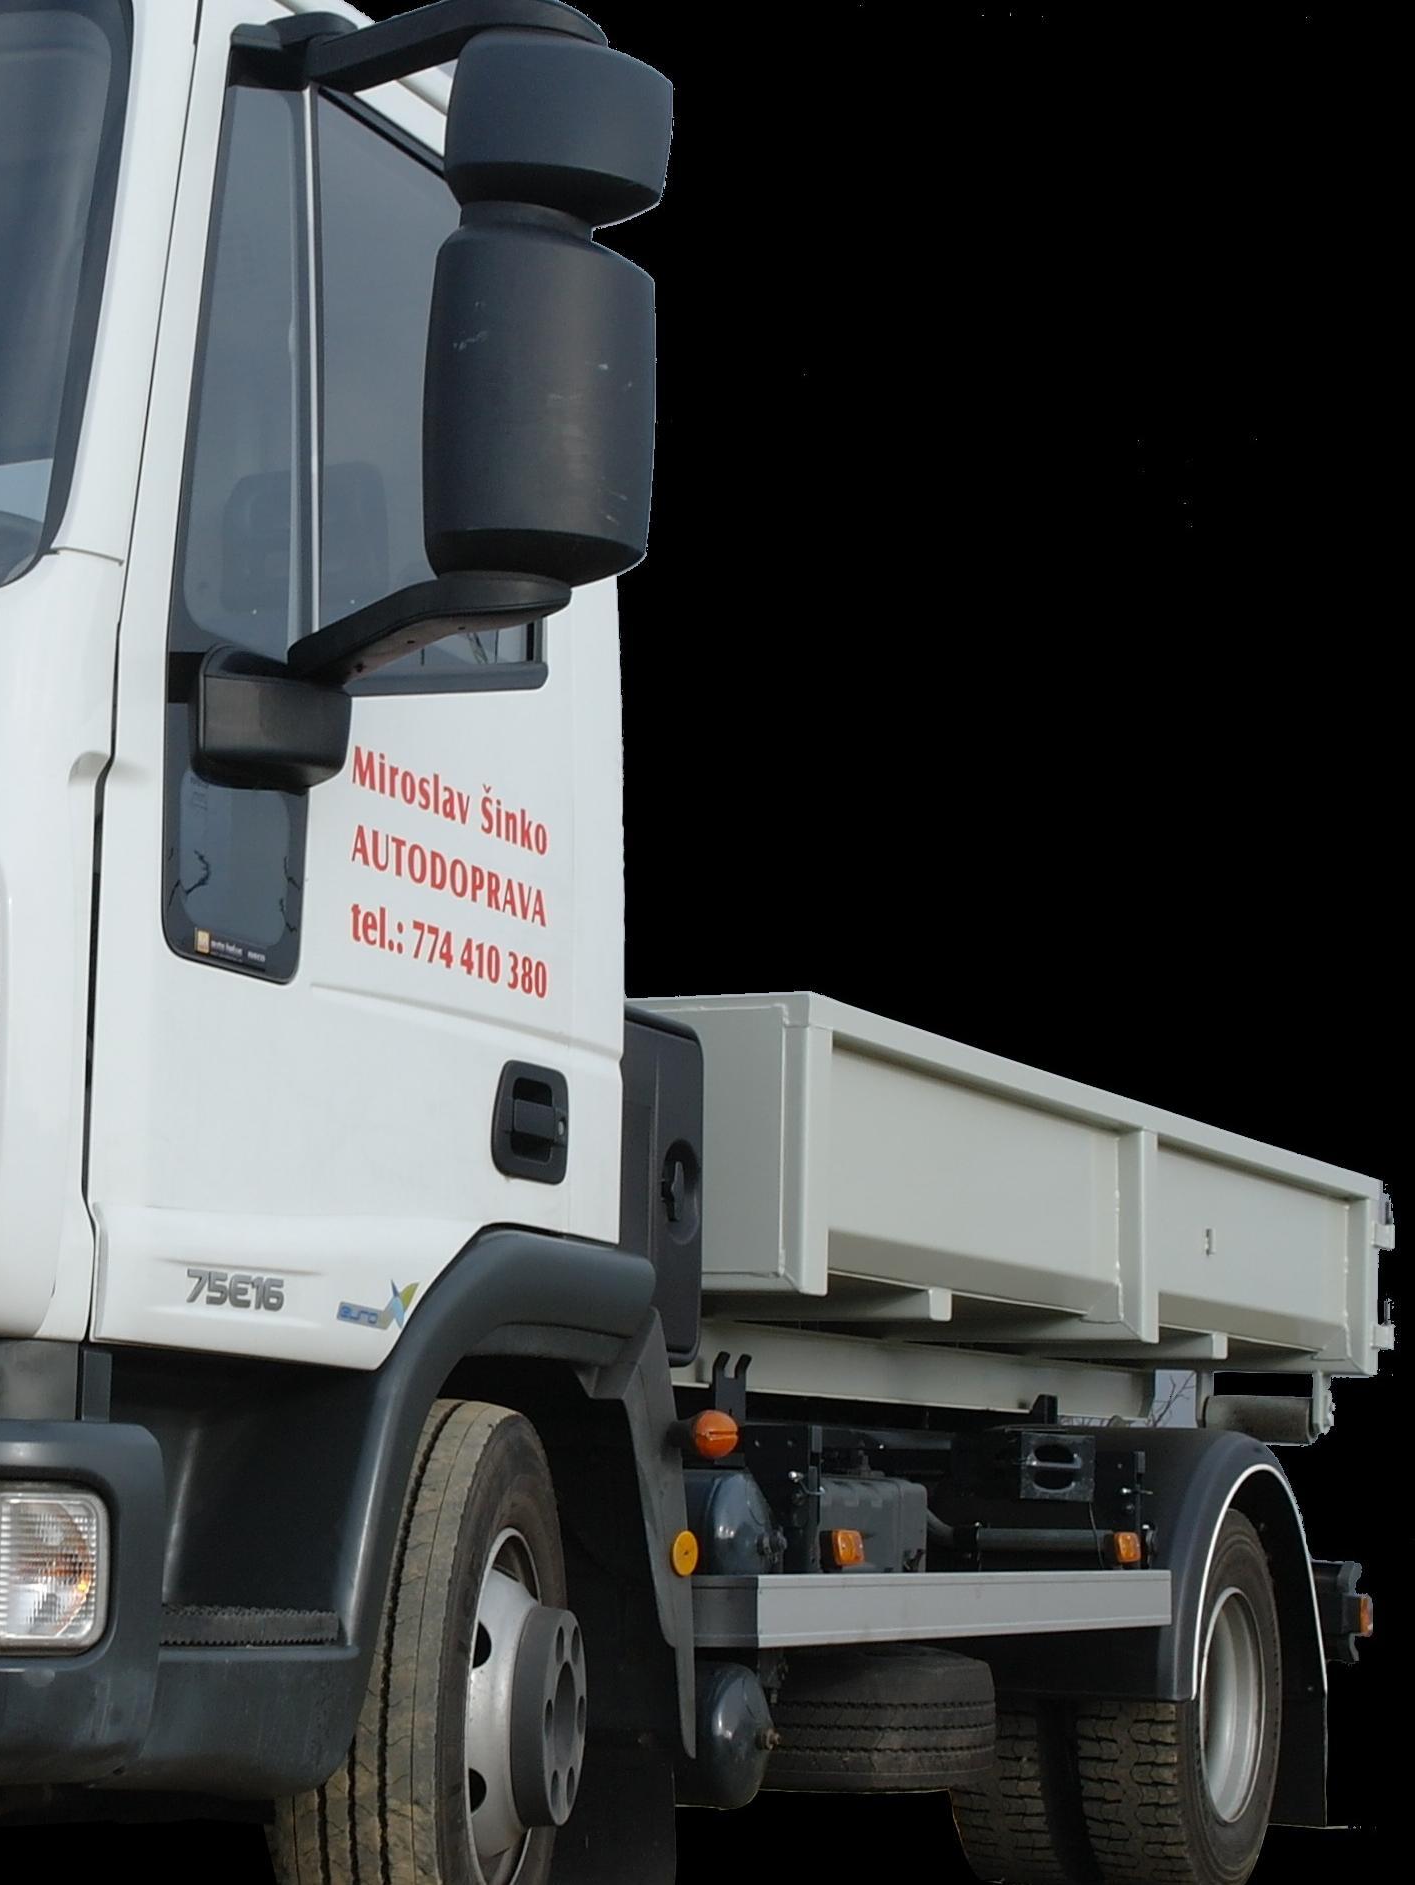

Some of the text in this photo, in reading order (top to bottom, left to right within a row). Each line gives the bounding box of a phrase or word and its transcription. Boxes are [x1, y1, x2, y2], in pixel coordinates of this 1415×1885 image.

[352, 746, 549, 856] Miroslav Šinko
[351, 825, 548, 927] AUTODOPRAVA
[351, 903, 549, 1000] tel.: 774 410 380
[186, 1268, 285, 1312] 75E16
